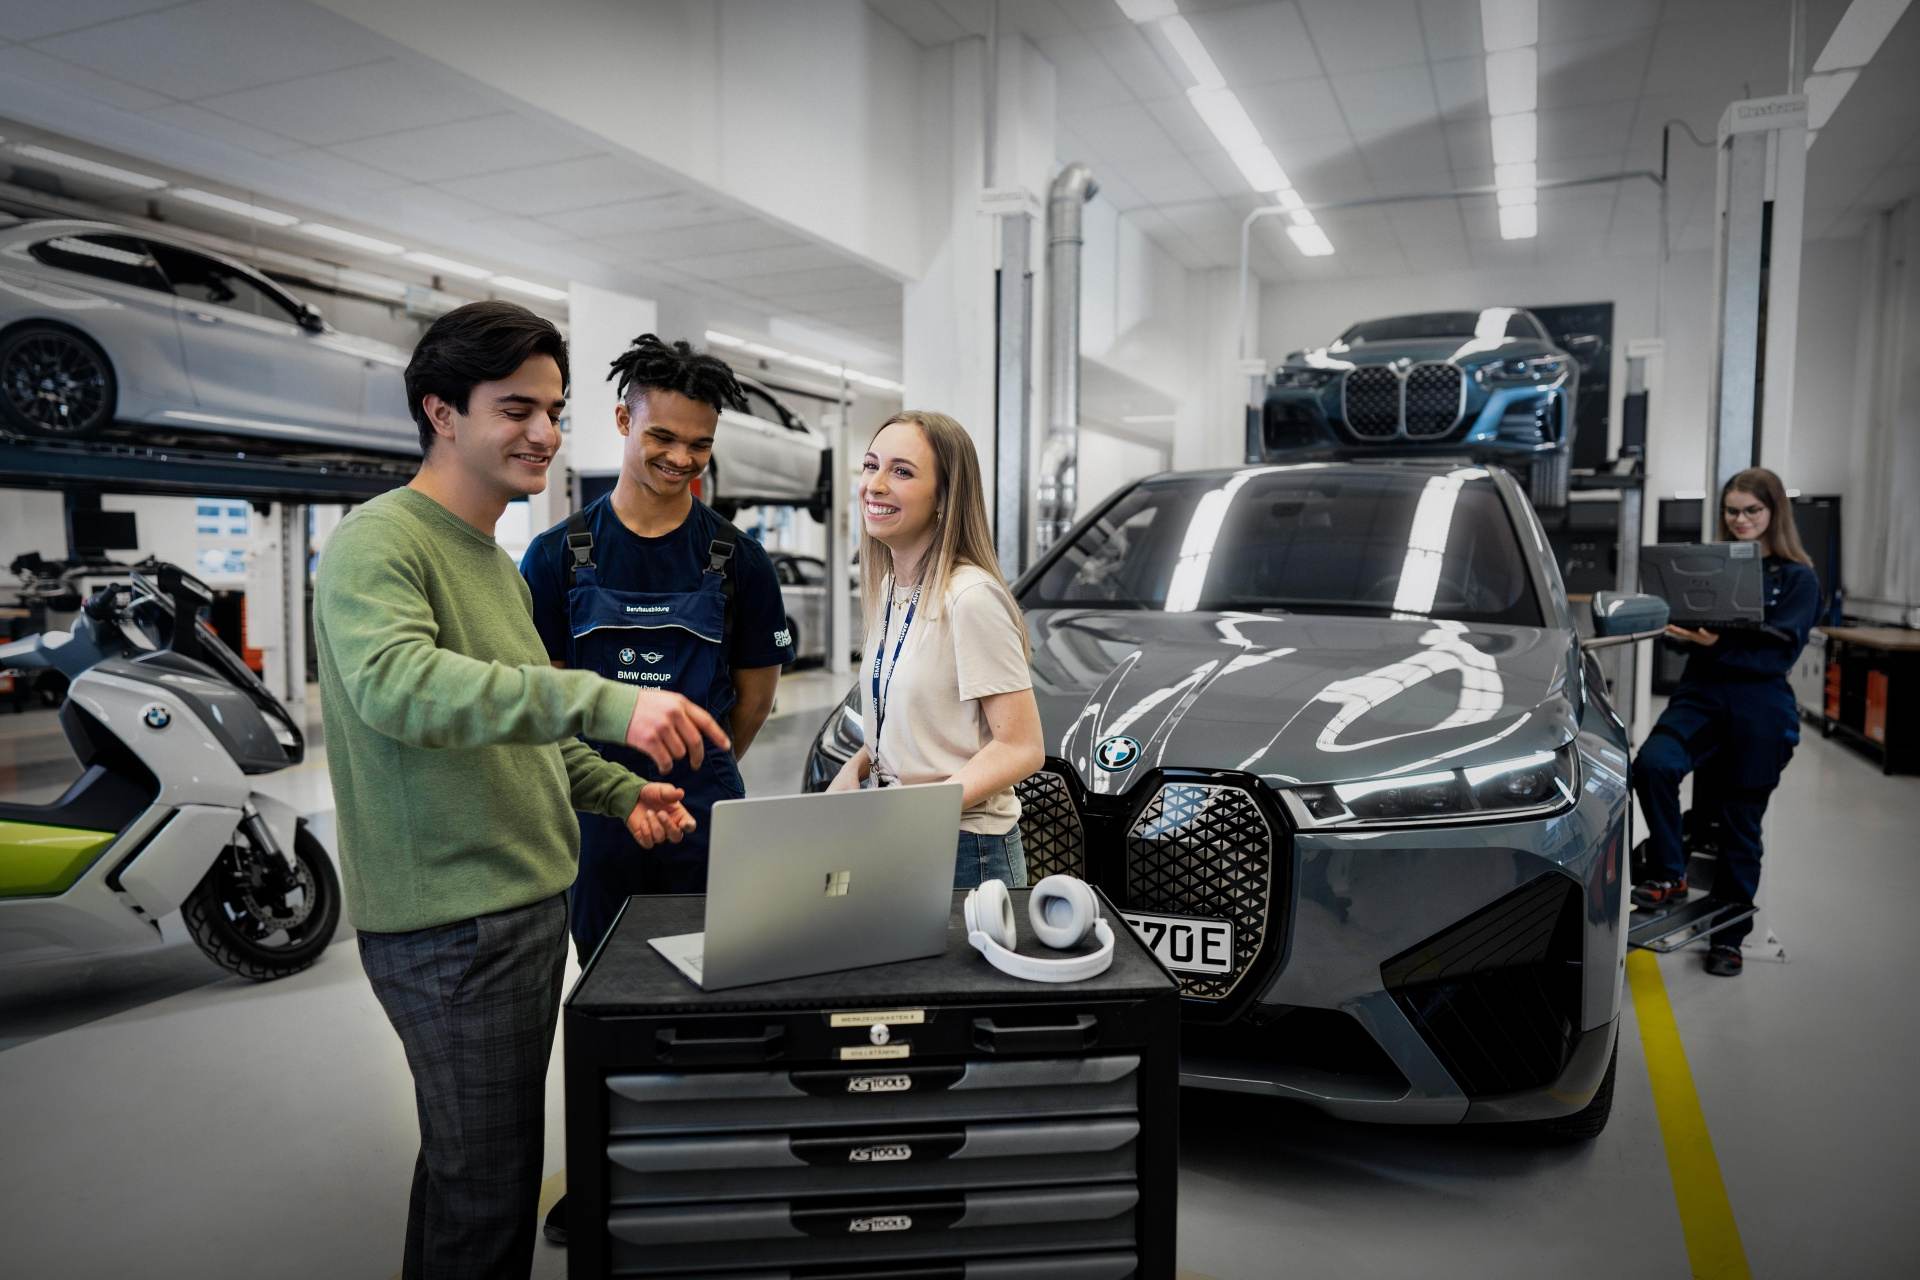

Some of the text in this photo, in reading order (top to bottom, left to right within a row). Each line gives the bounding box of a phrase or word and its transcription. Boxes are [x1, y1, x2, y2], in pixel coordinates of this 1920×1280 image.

[617, 671, 671, 681] BMW GROUP
[873, 658, 882, 679] BMW
[1126, 920, 1227, 966] 70E
